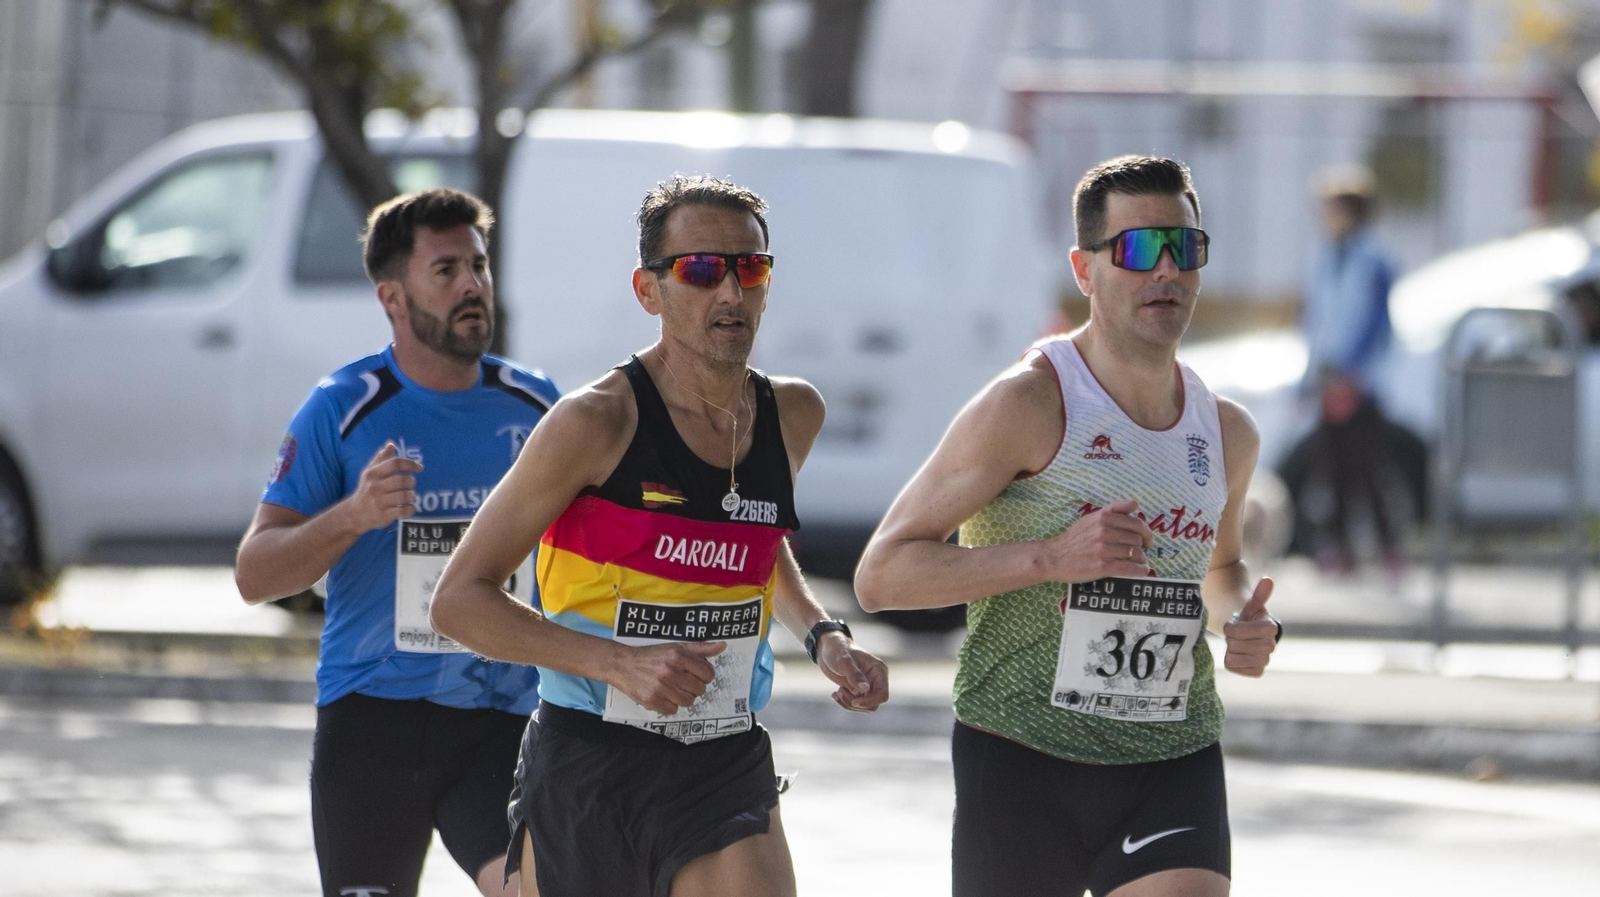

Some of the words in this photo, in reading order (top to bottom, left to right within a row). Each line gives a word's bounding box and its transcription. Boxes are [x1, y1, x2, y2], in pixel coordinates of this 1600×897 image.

[407, 526, 443, 538] XLV
[655, 535, 748, 571] DAROALI
[1078, 595, 1150, 612] POPULAR
[627, 606, 665, 622] XLV
[686, 606, 758, 624] CARRERA
[399, 629, 435, 648] enjoy!
[625, 621, 706, 638] POPULAR
[712, 621, 757, 637] JEREZ
[1096, 629, 1187, 682] 367
